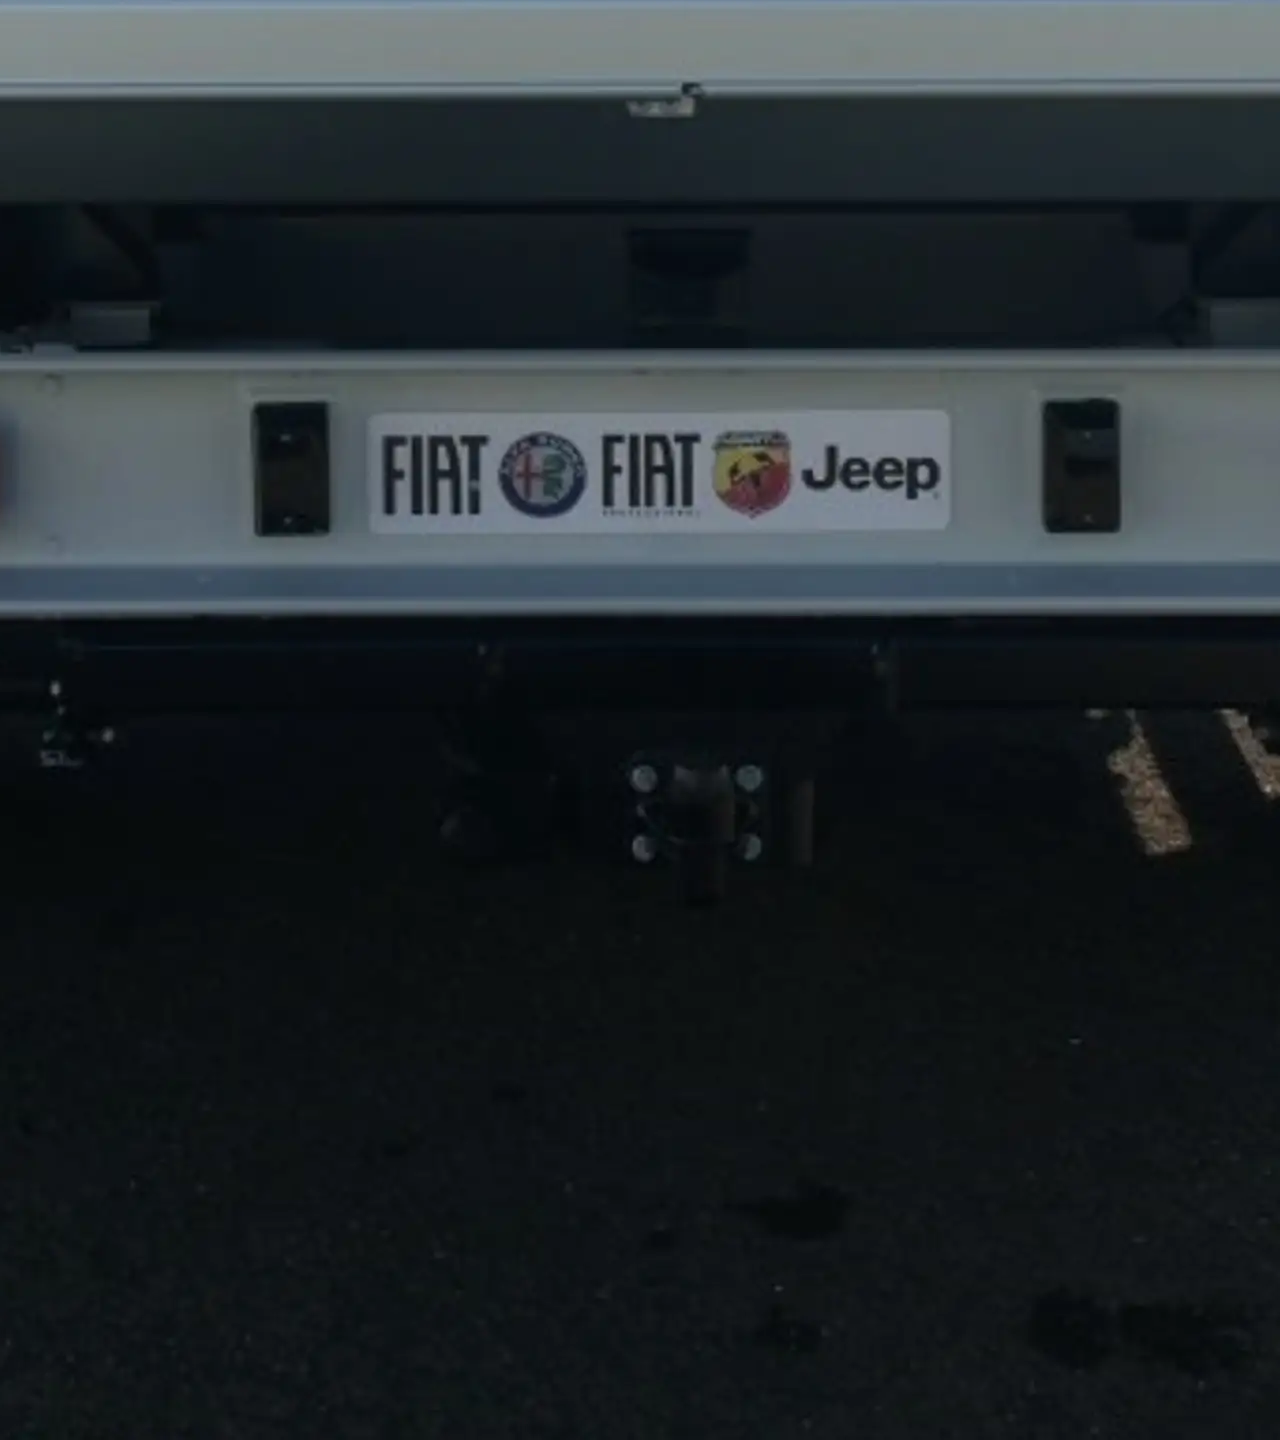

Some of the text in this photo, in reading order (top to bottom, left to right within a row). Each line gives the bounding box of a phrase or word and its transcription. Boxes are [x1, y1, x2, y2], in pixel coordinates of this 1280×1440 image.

[382, 435, 489, 516] FIAT
[602, 433, 701, 508] FIAT
[802, 445, 940, 500] Jeep
